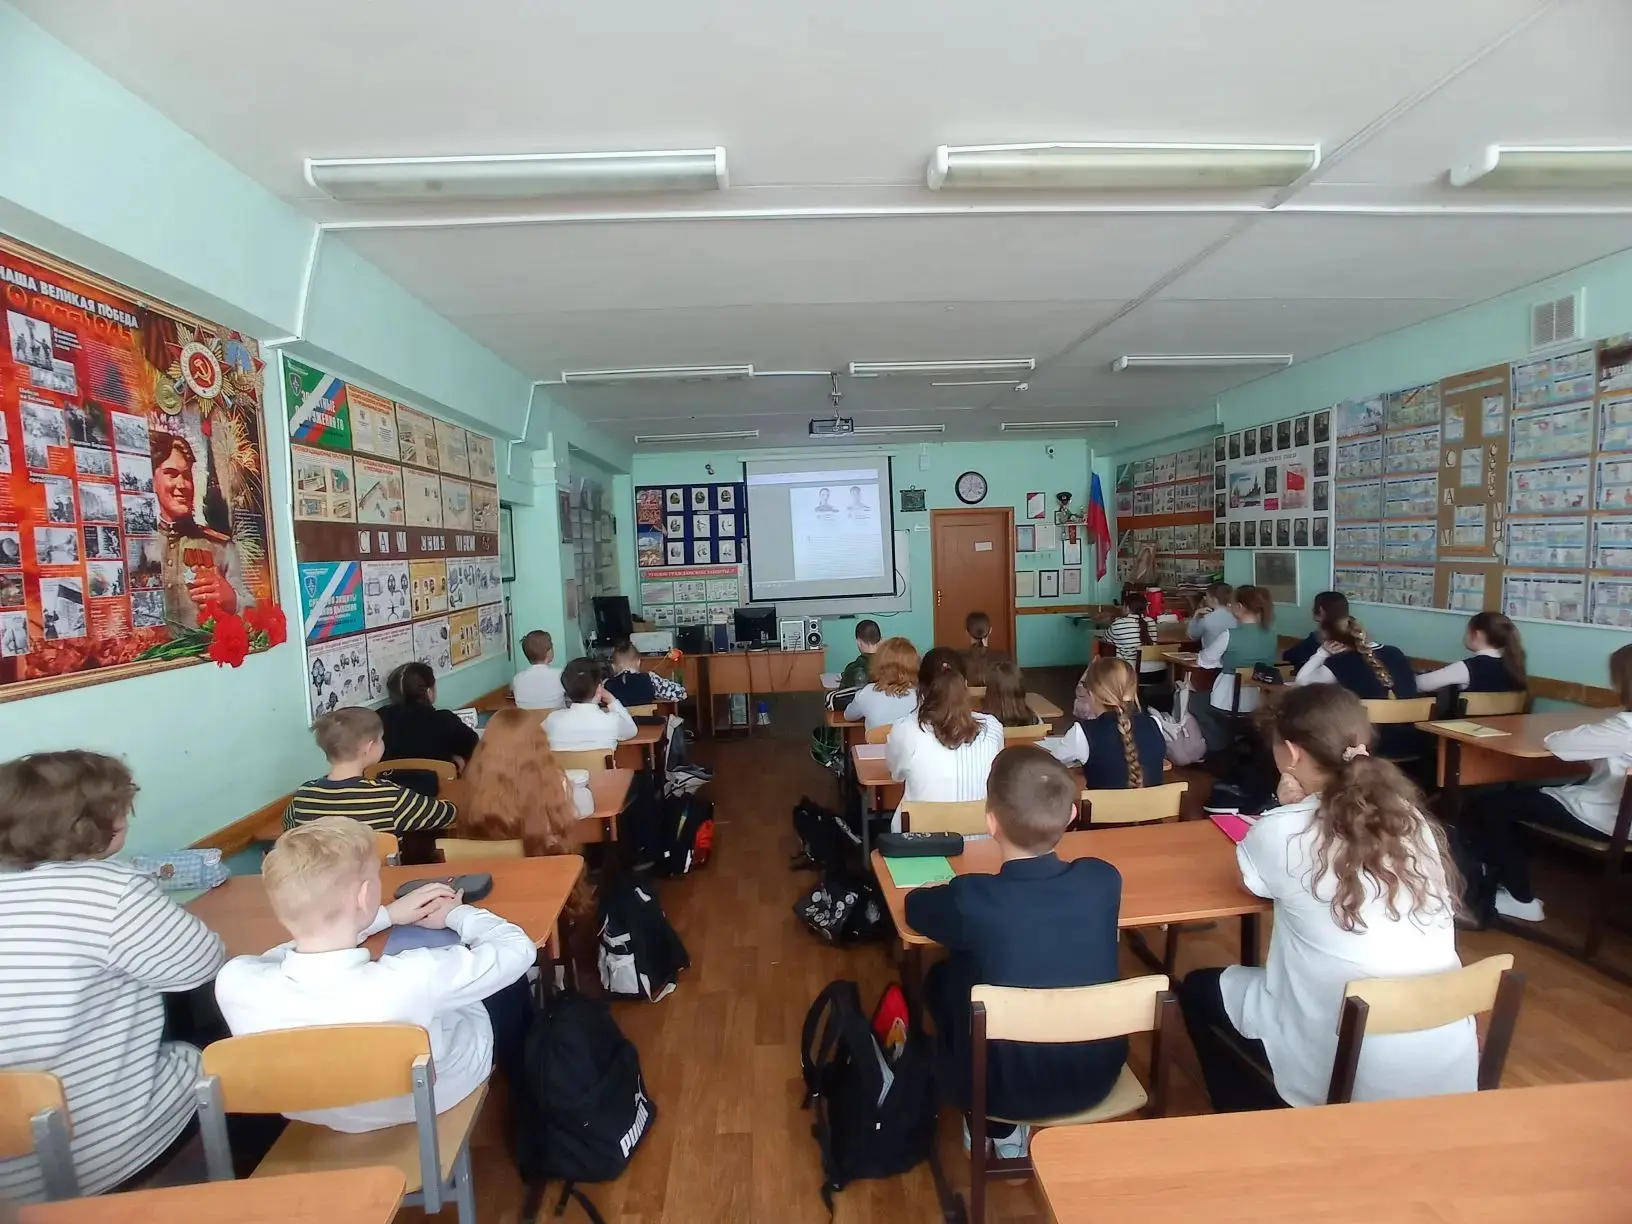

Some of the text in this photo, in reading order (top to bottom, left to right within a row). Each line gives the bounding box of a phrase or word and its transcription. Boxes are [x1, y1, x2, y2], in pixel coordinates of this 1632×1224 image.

[39, 280, 96, 313] ВЕЛИКАЯ
[97, 302, 139, 329] ПОБЕДА
[620, 1100, 649, 1159] PUMA
